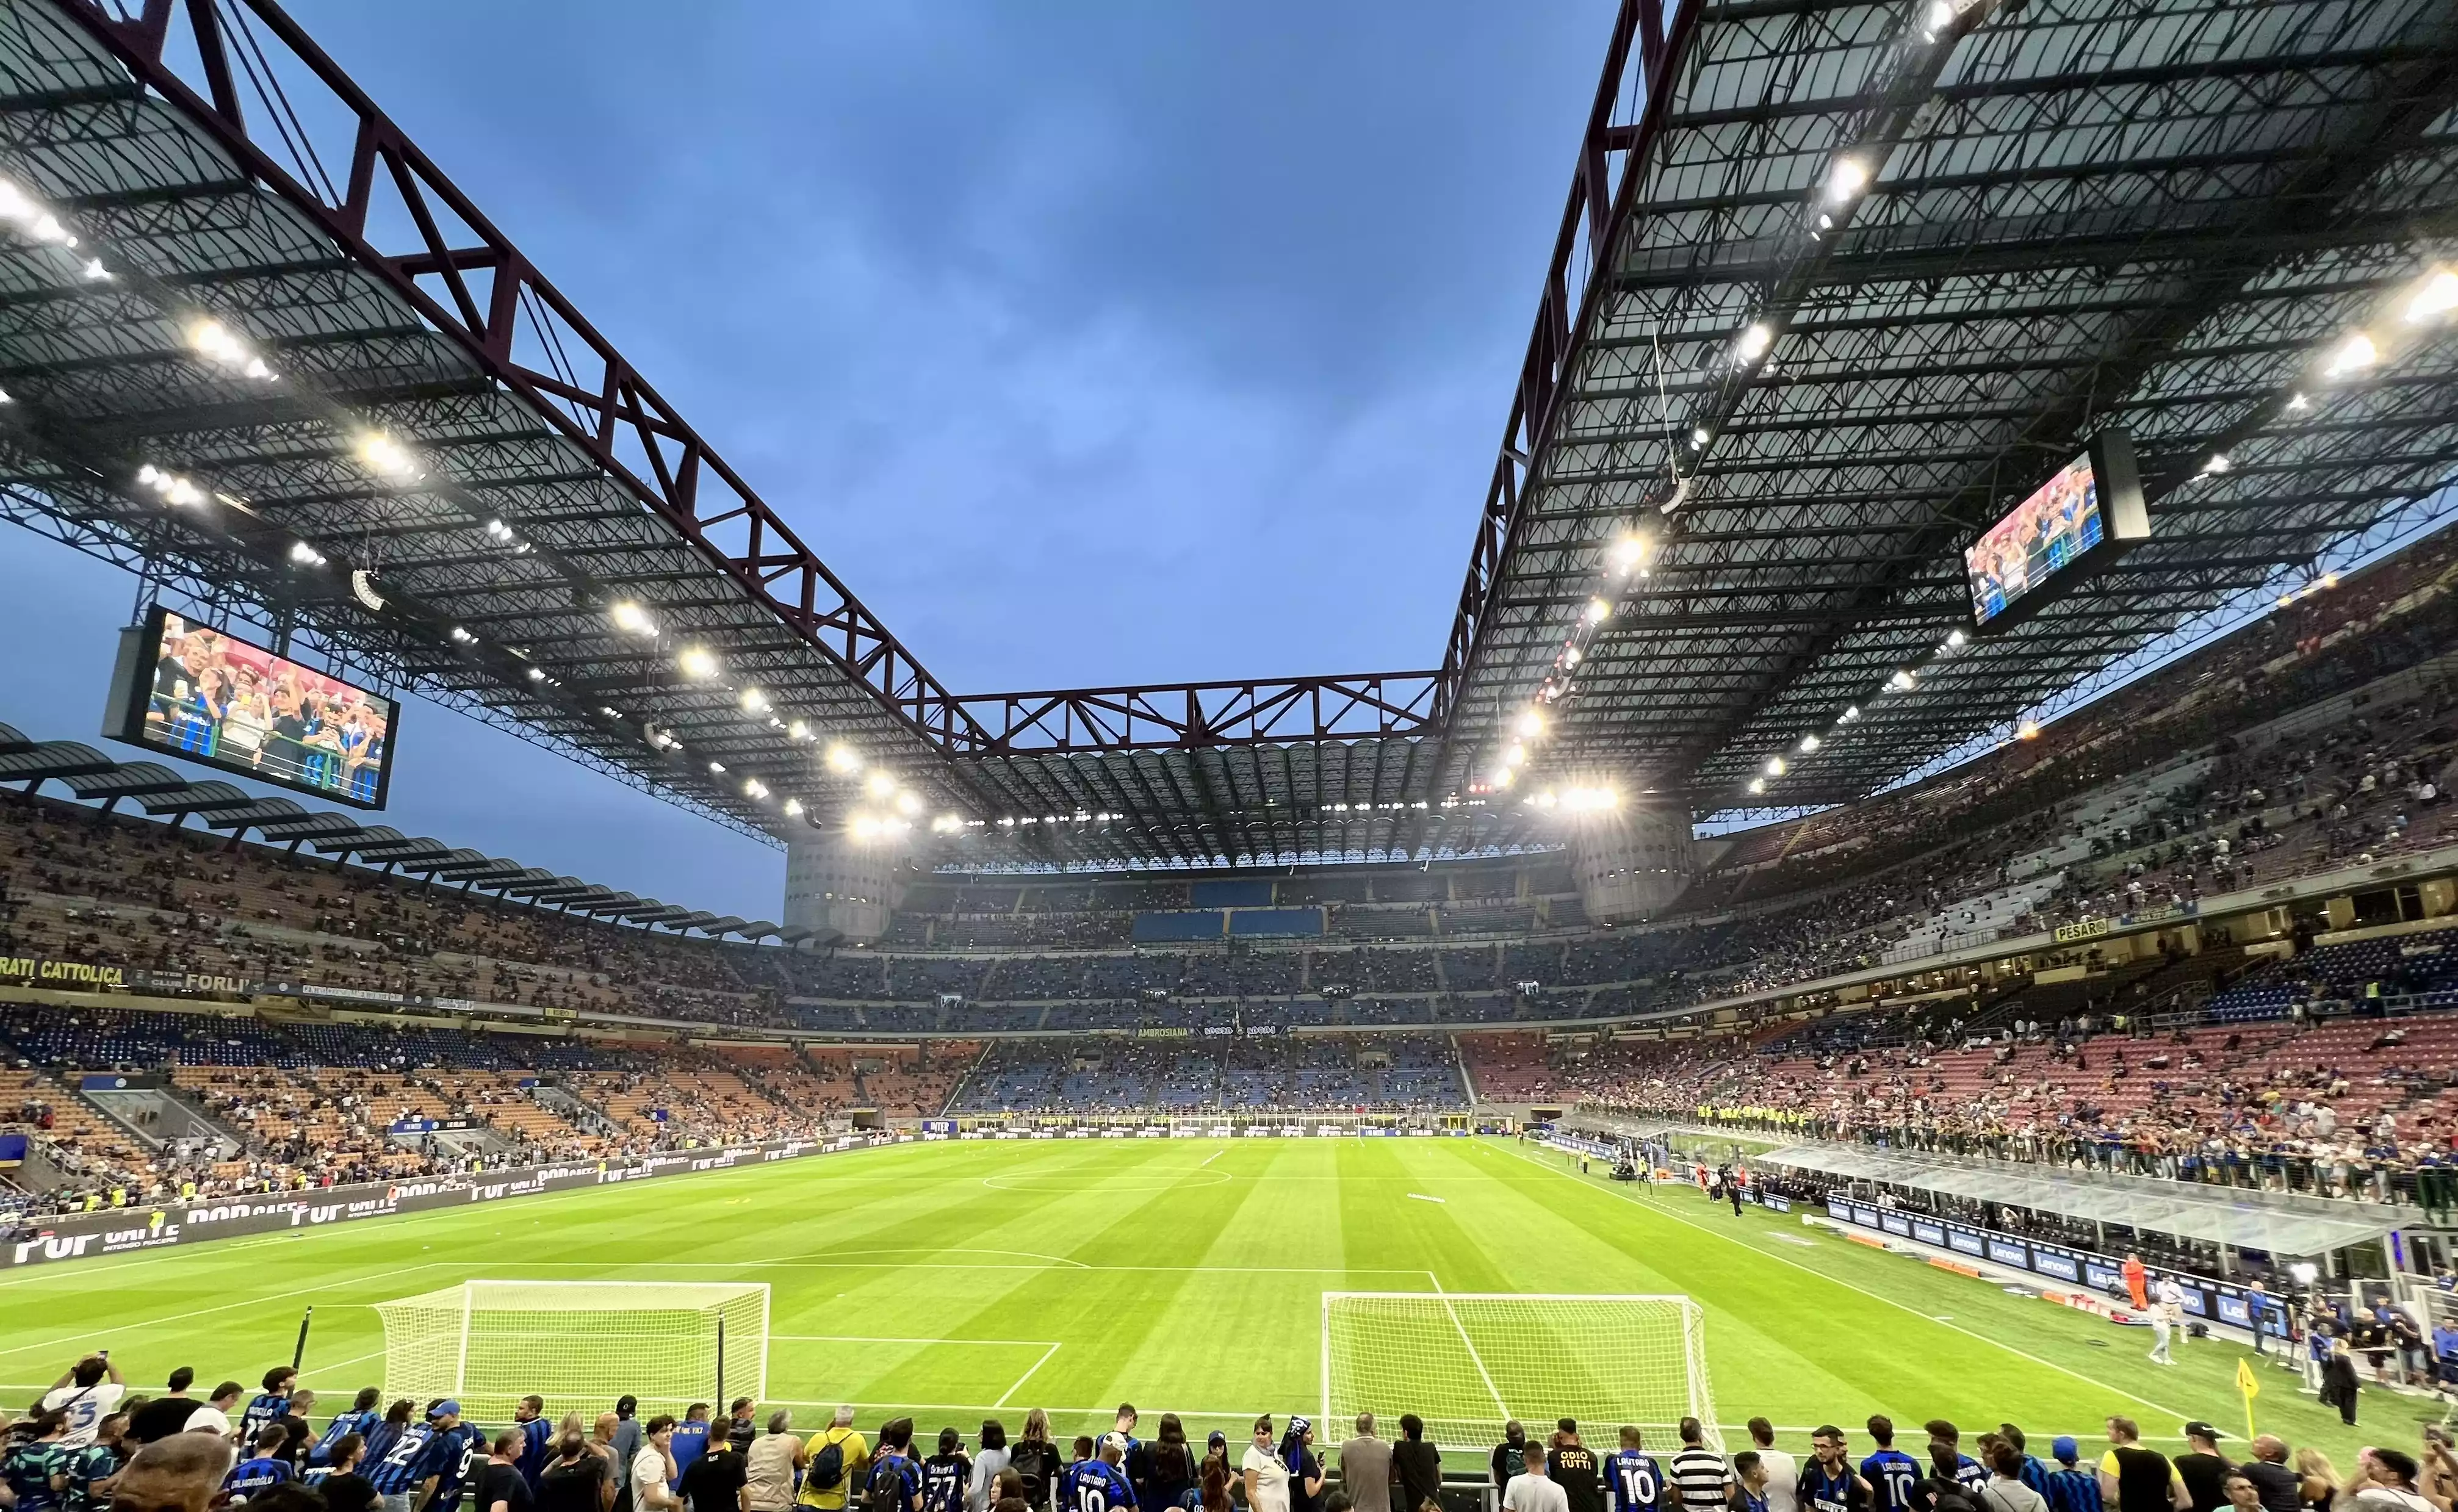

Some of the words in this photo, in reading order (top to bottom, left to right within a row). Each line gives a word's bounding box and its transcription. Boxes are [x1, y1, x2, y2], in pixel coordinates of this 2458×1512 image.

[0, 956, 35, 976] RATI
[41, 960, 122, 984] CATTOLICA
[1138, 1028, 1189, 1037] AMBROSIANA
[930, 1121, 949, 1132] INTER
[1884, 1217, 1907, 1232] Lenovo
[1916, 1225, 1942, 1241] Lenovo
[1952, 1234, 1980, 1251] Lenovo
[1991, 1245, 2024, 1262] Lenovo
[2037, 1256, 2074, 1275] Lenovo
[383, 1435, 422, 1466] 22
[1560, 1451, 1588, 1460] ODIO
[456, 1448, 474, 1478] 9
[1560, 1460, 1591, 1471] TUTTI
[1616, 1457, 1649, 1467] LAUTARO
[1881, 1463, 1912, 1472] LAUTARO
[1079, 1472, 1106, 1488] LAUTARO
[1620, 1469, 1656, 1504] 10
[1078, 1485, 1105, 1512] 10
[1884, 1474, 1915, 1508] 10
